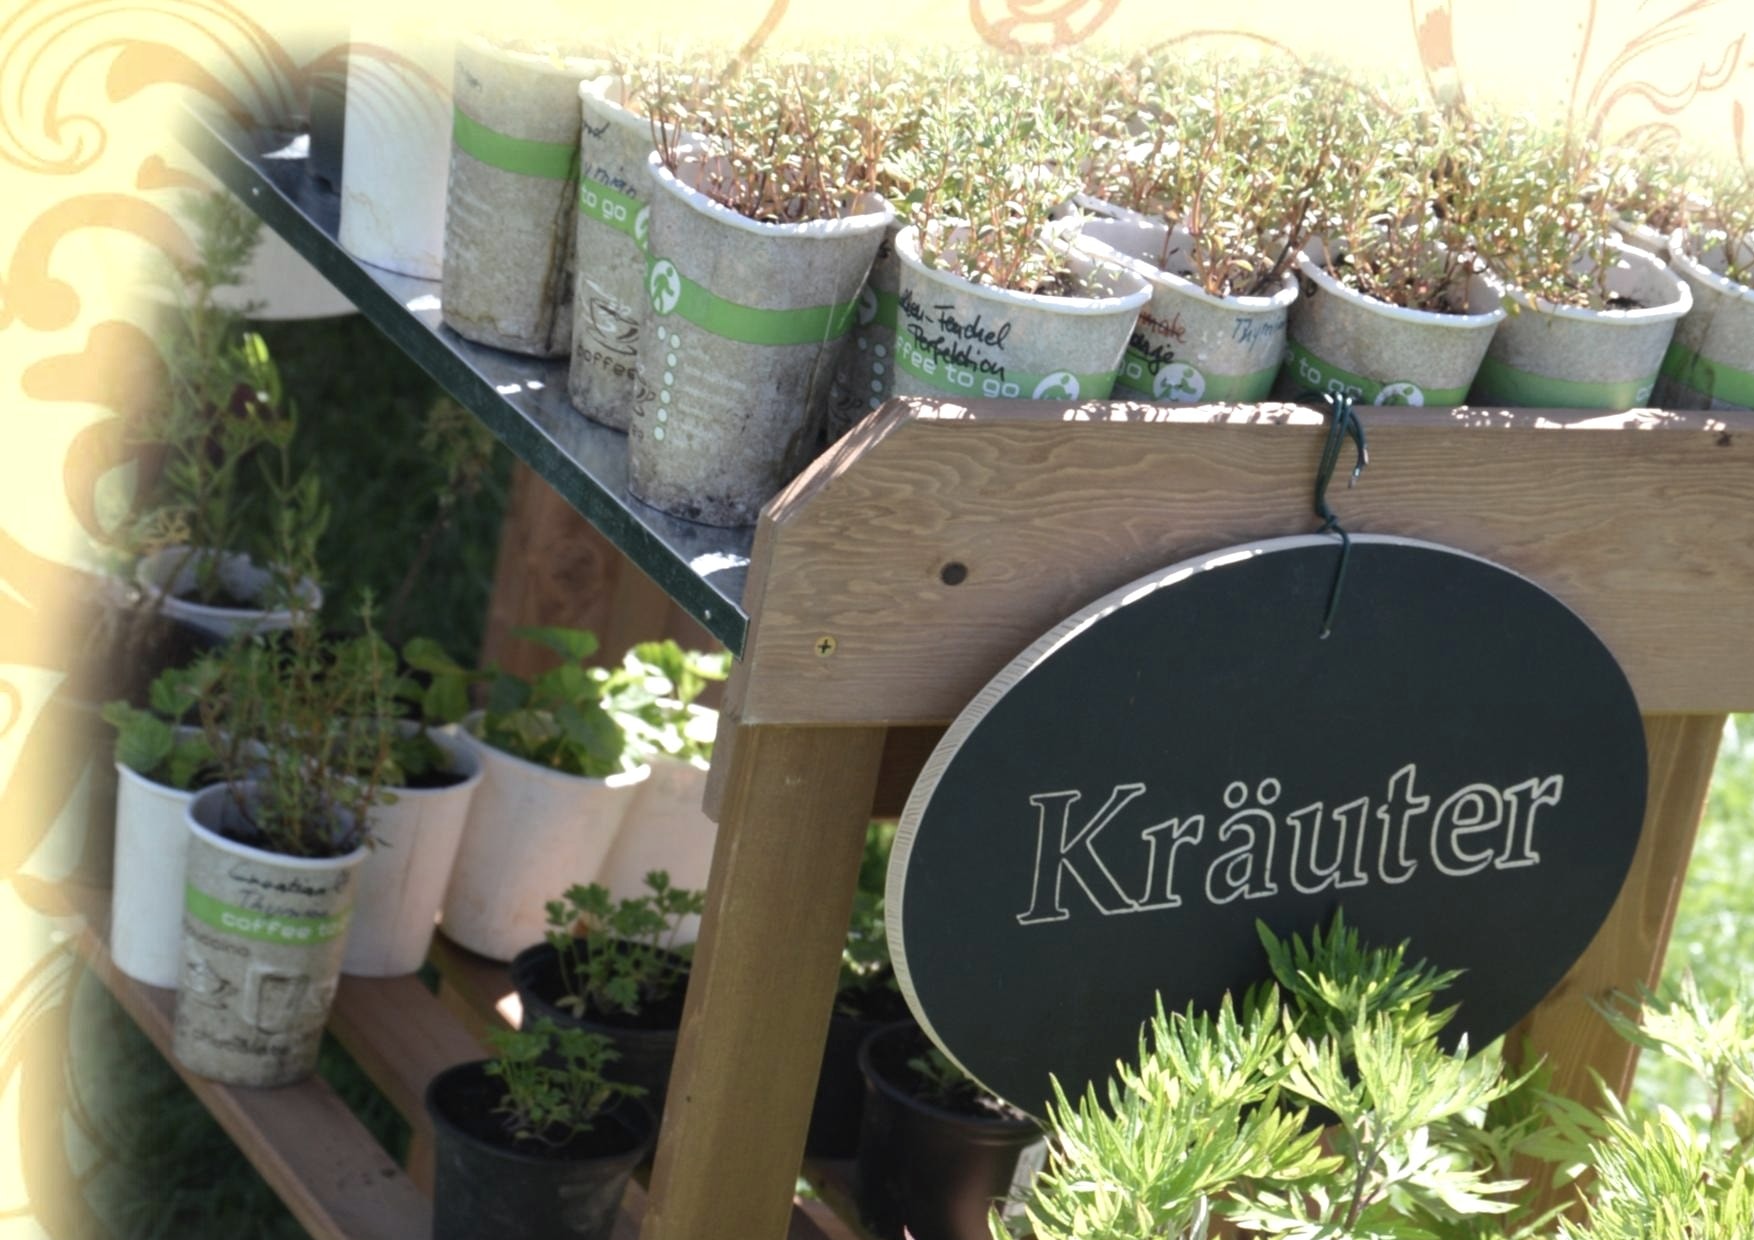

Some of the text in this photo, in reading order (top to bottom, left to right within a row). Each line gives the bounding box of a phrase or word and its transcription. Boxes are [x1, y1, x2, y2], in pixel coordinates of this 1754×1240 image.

[602, 200, 627, 221] go
[945, 364, 974, 388] to
[983, 378, 1020, 399] go
[1016, 763, 1563, 924] Kräuter
[221, 911, 311, 939] coffee
